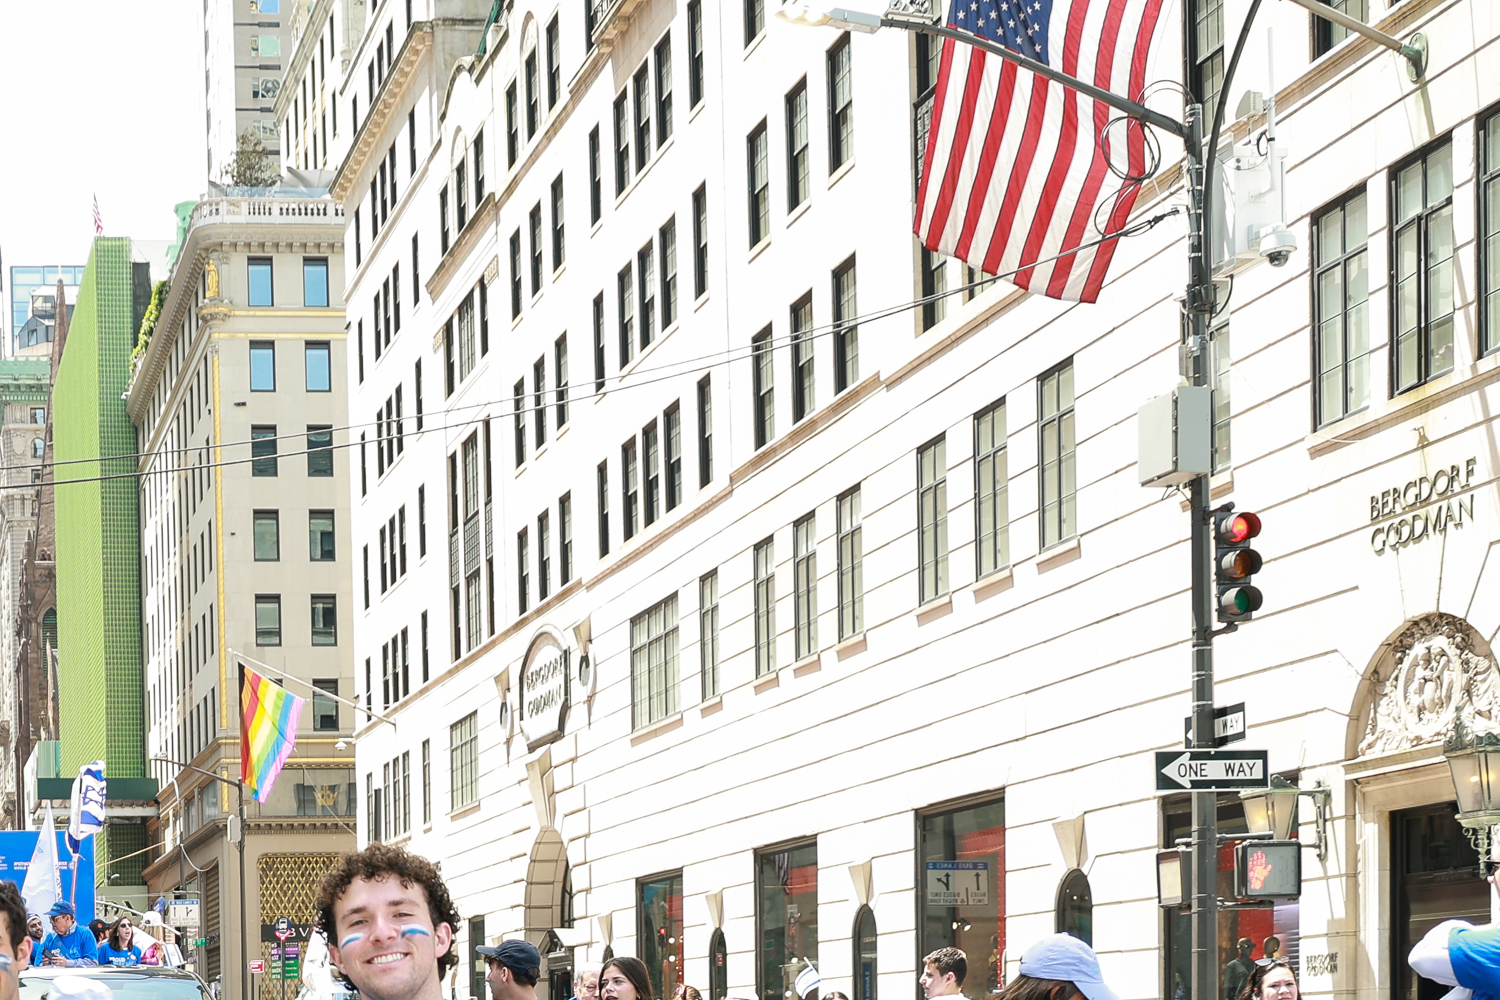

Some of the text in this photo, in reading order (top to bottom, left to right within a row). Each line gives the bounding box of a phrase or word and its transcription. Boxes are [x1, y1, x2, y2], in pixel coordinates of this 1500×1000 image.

[1370, 456, 1477, 521] BERGDORF
[1371, 494, 1474, 554] GOODMAN
[1221, 716, 1240, 734] WAY
[1177, 762, 1257, 778] ONE WAY
